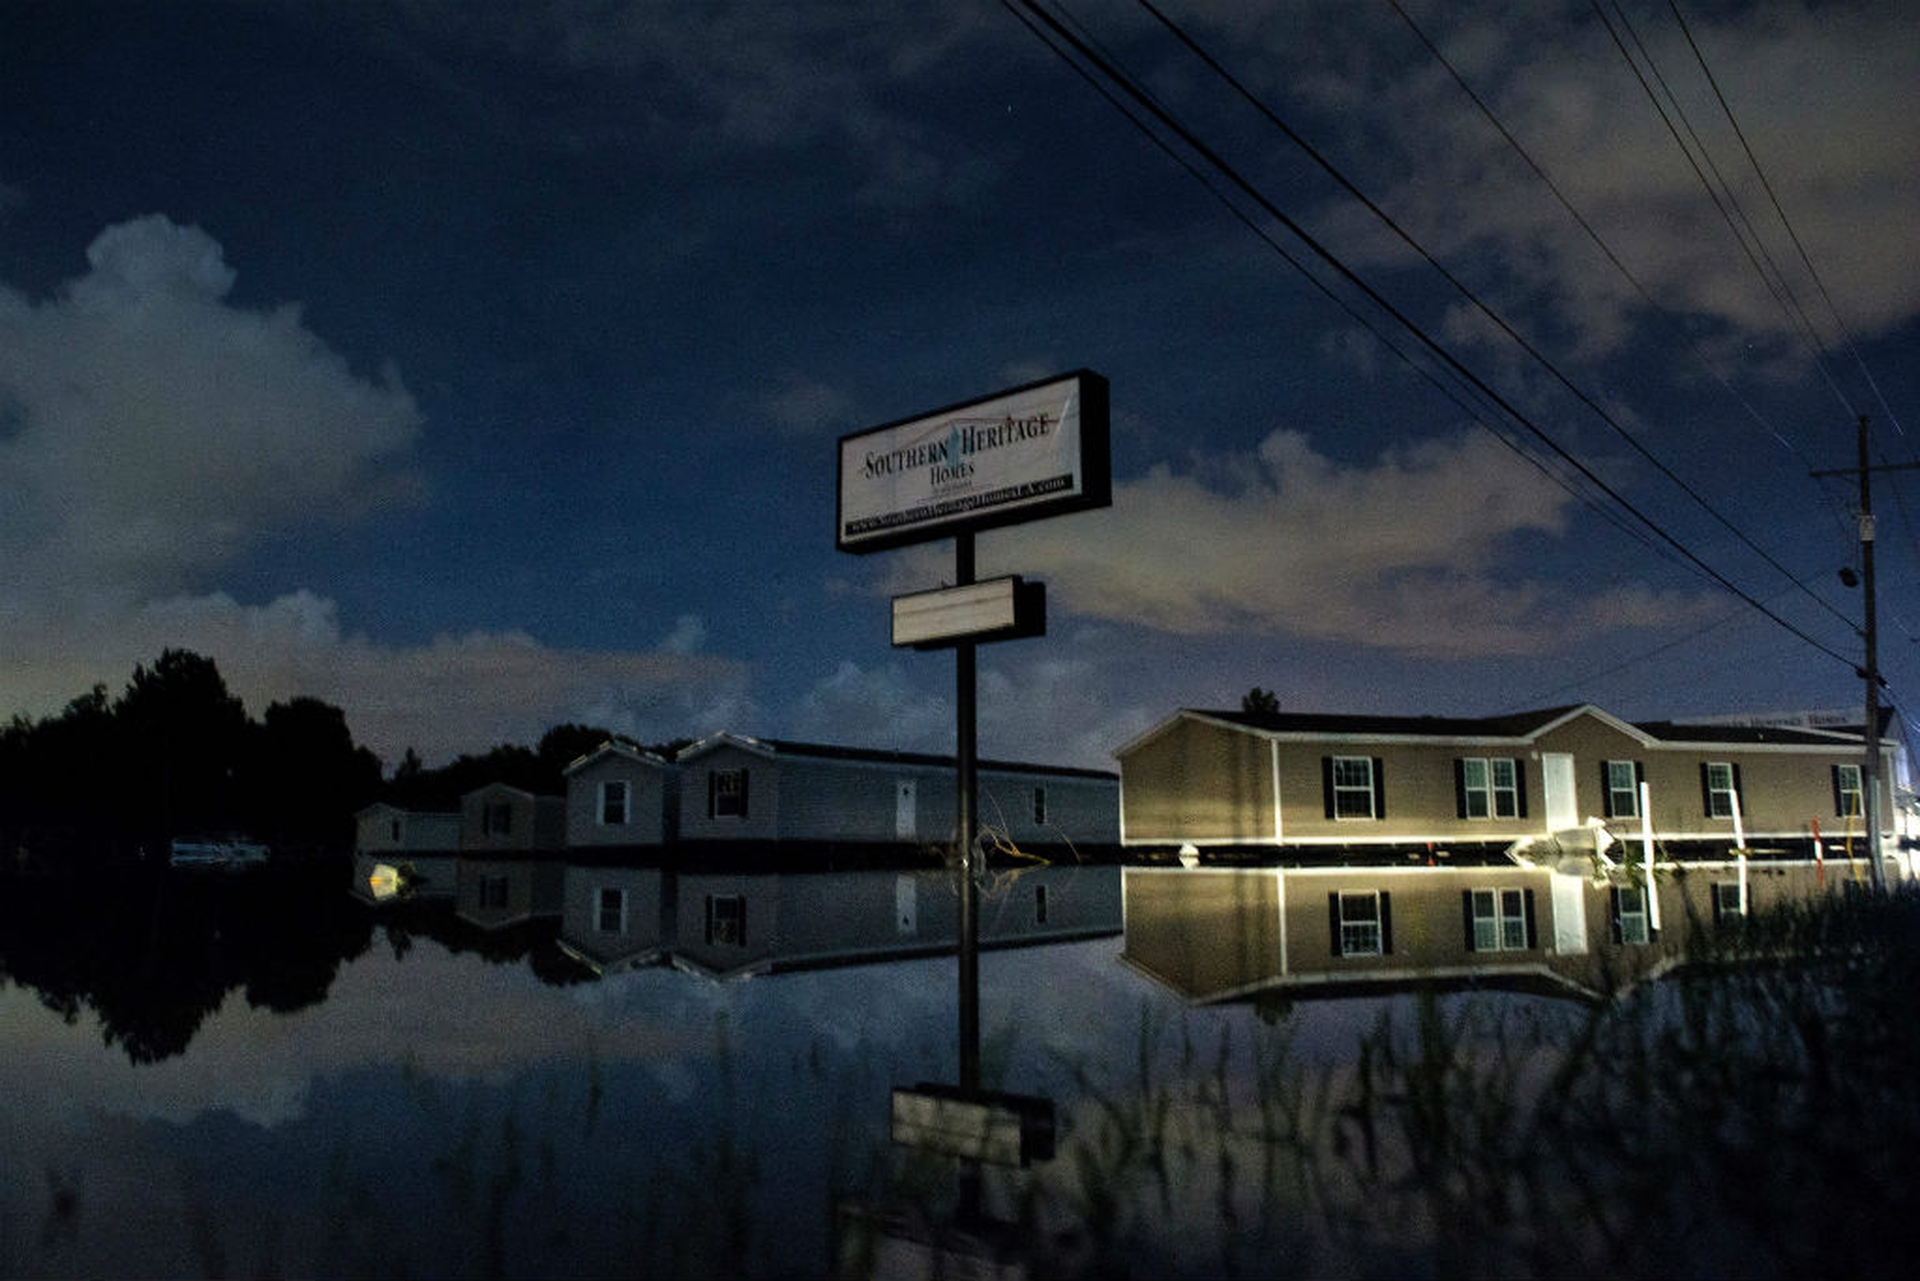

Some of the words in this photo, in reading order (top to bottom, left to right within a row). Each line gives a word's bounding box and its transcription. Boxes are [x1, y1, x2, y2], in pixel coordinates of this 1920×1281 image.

[865, 438, 948, 479] SOUTHERN
[961, 413, 1050, 455] HERITAGE
[930, 463, 975, 486] HOMES
